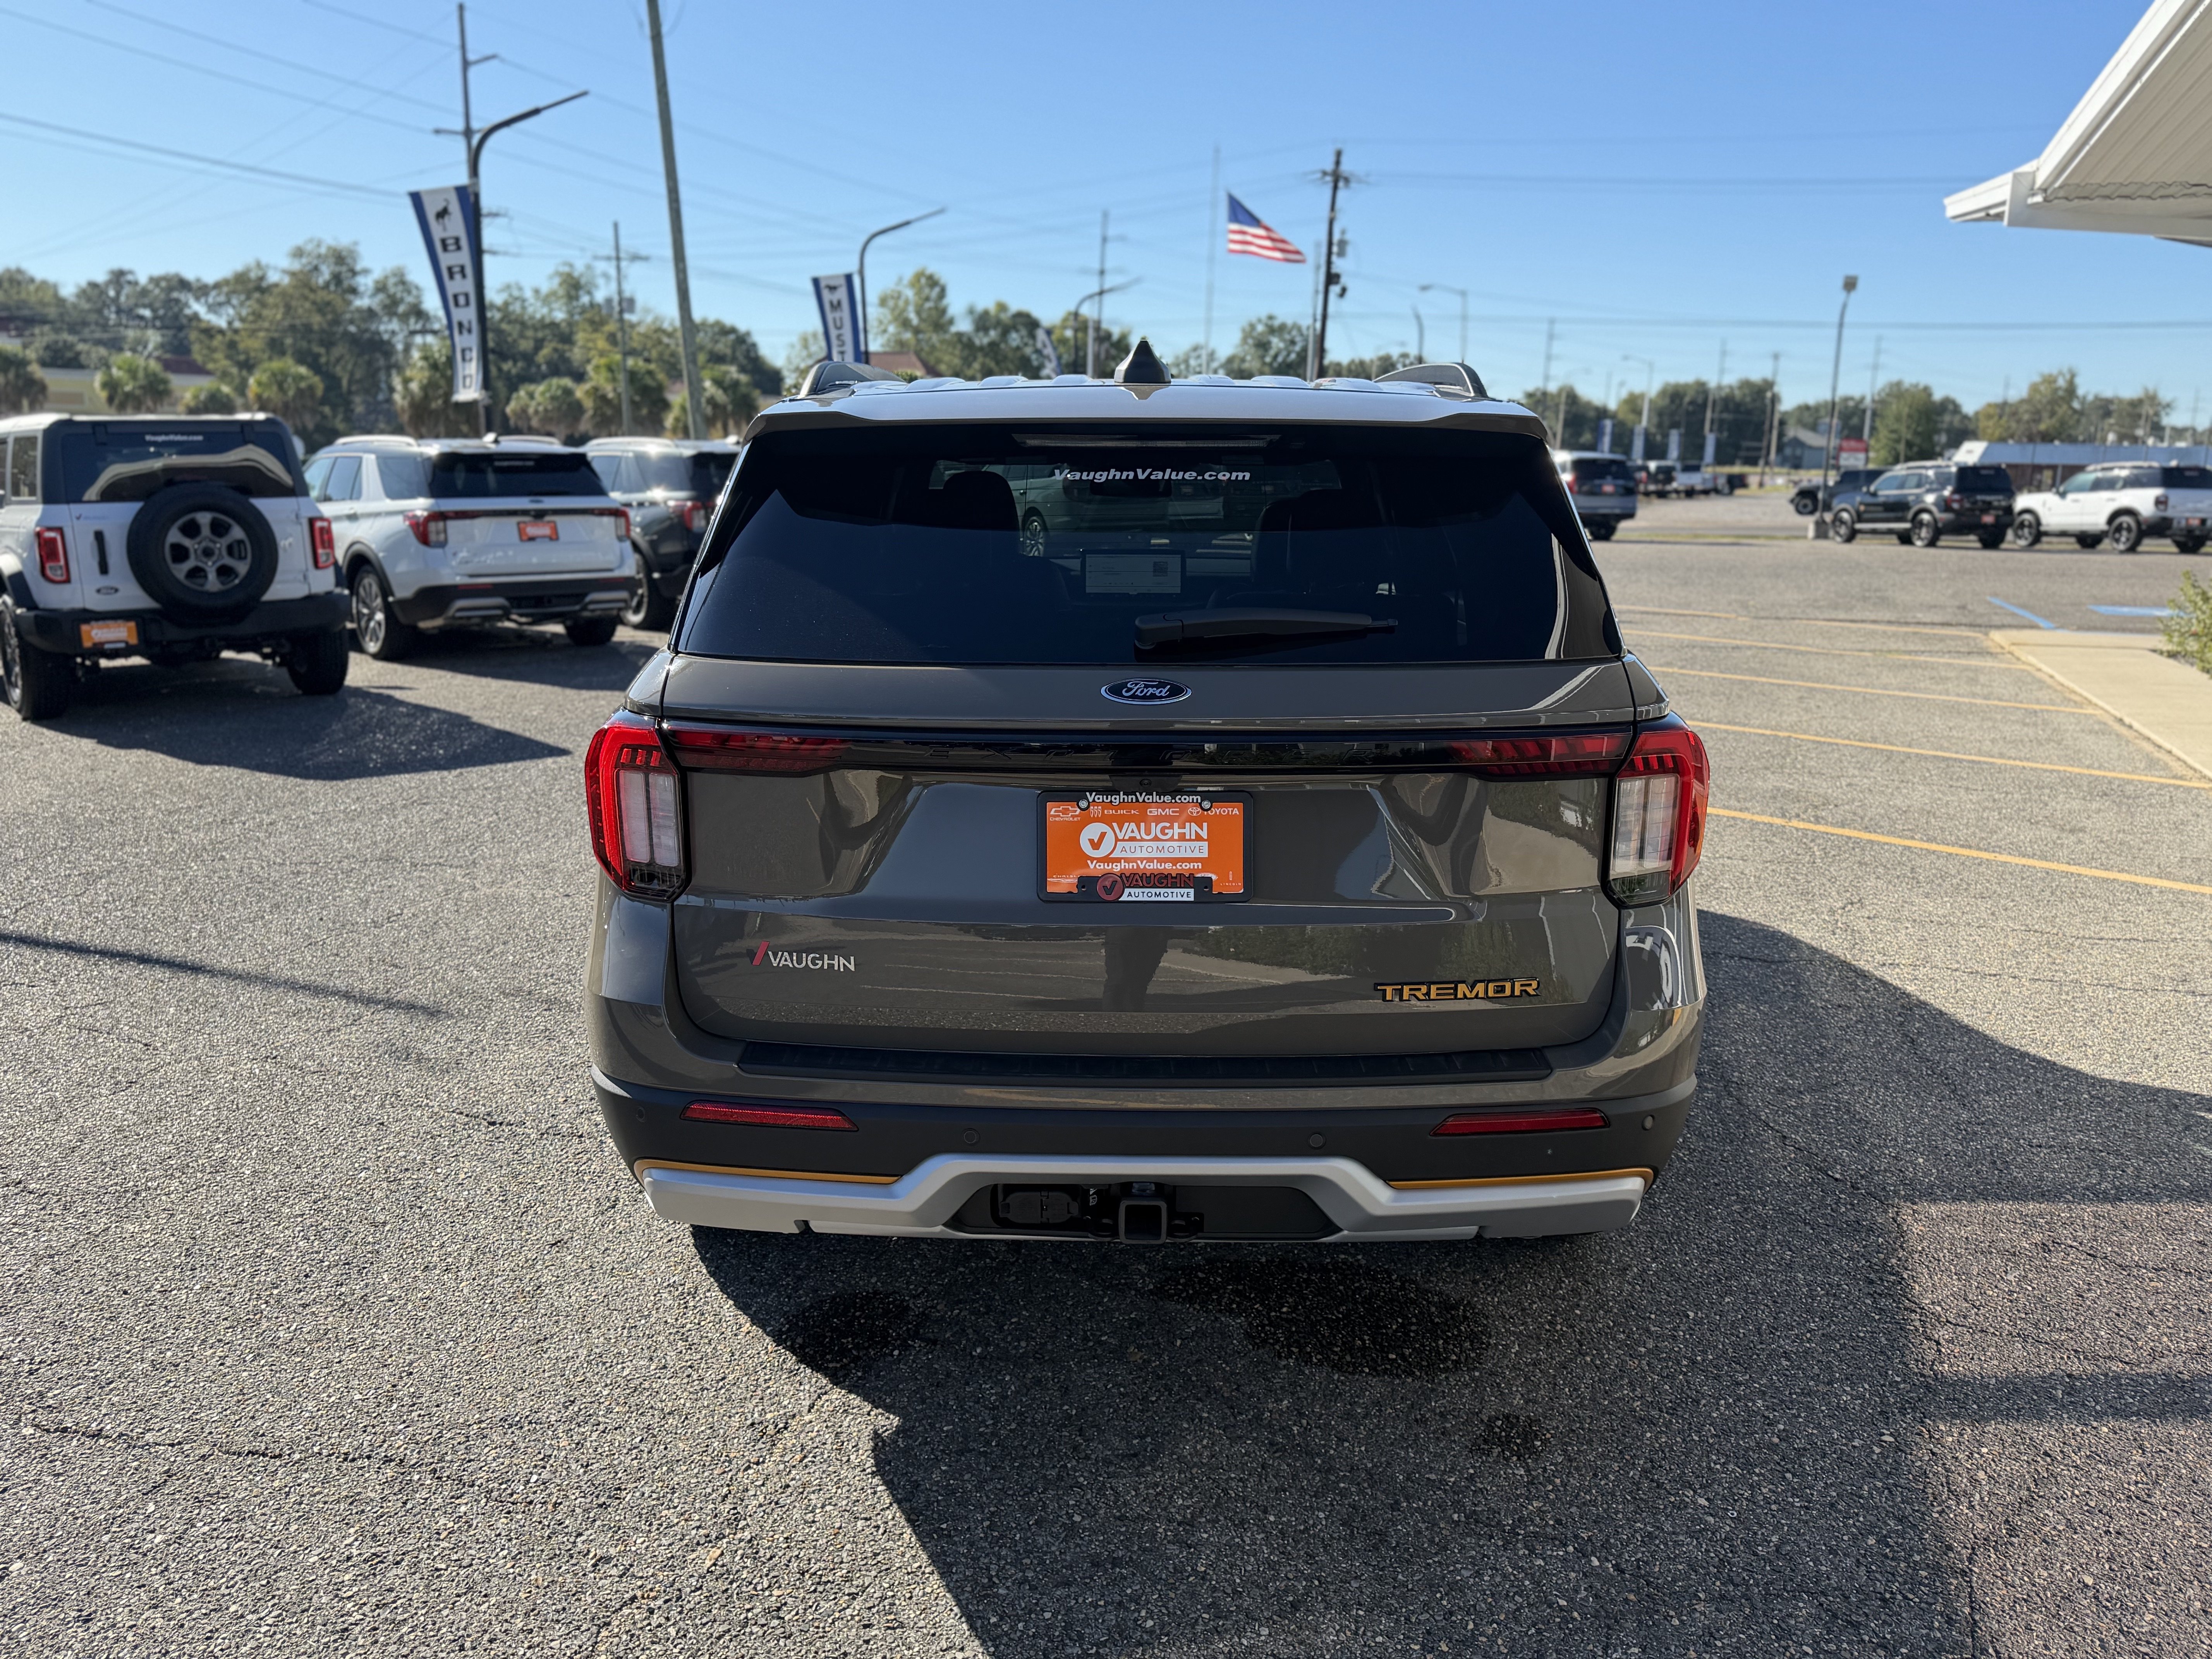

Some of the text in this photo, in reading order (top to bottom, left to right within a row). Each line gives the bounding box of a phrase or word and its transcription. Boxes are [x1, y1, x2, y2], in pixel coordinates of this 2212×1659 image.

[440, 236, 474, 389] BRONCO
[1054, 468, 1250, 482] VaughnValue.com
[1122, 681, 1171, 696] Ford
[1086, 792, 1201, 805] VaughnValue.com
[1112, 822, 1207, 840] VAUGHN
[1120, 845, 1204, 854] AUTOMOTIVE
[1087, 859, 1202, 872] VaughnValue.com
[1121, 873, 1194, 888] VAUGHN
[768, 951, 855, 972] VAUGHN
[1374, 977, 1540, 1001] TREMOR
